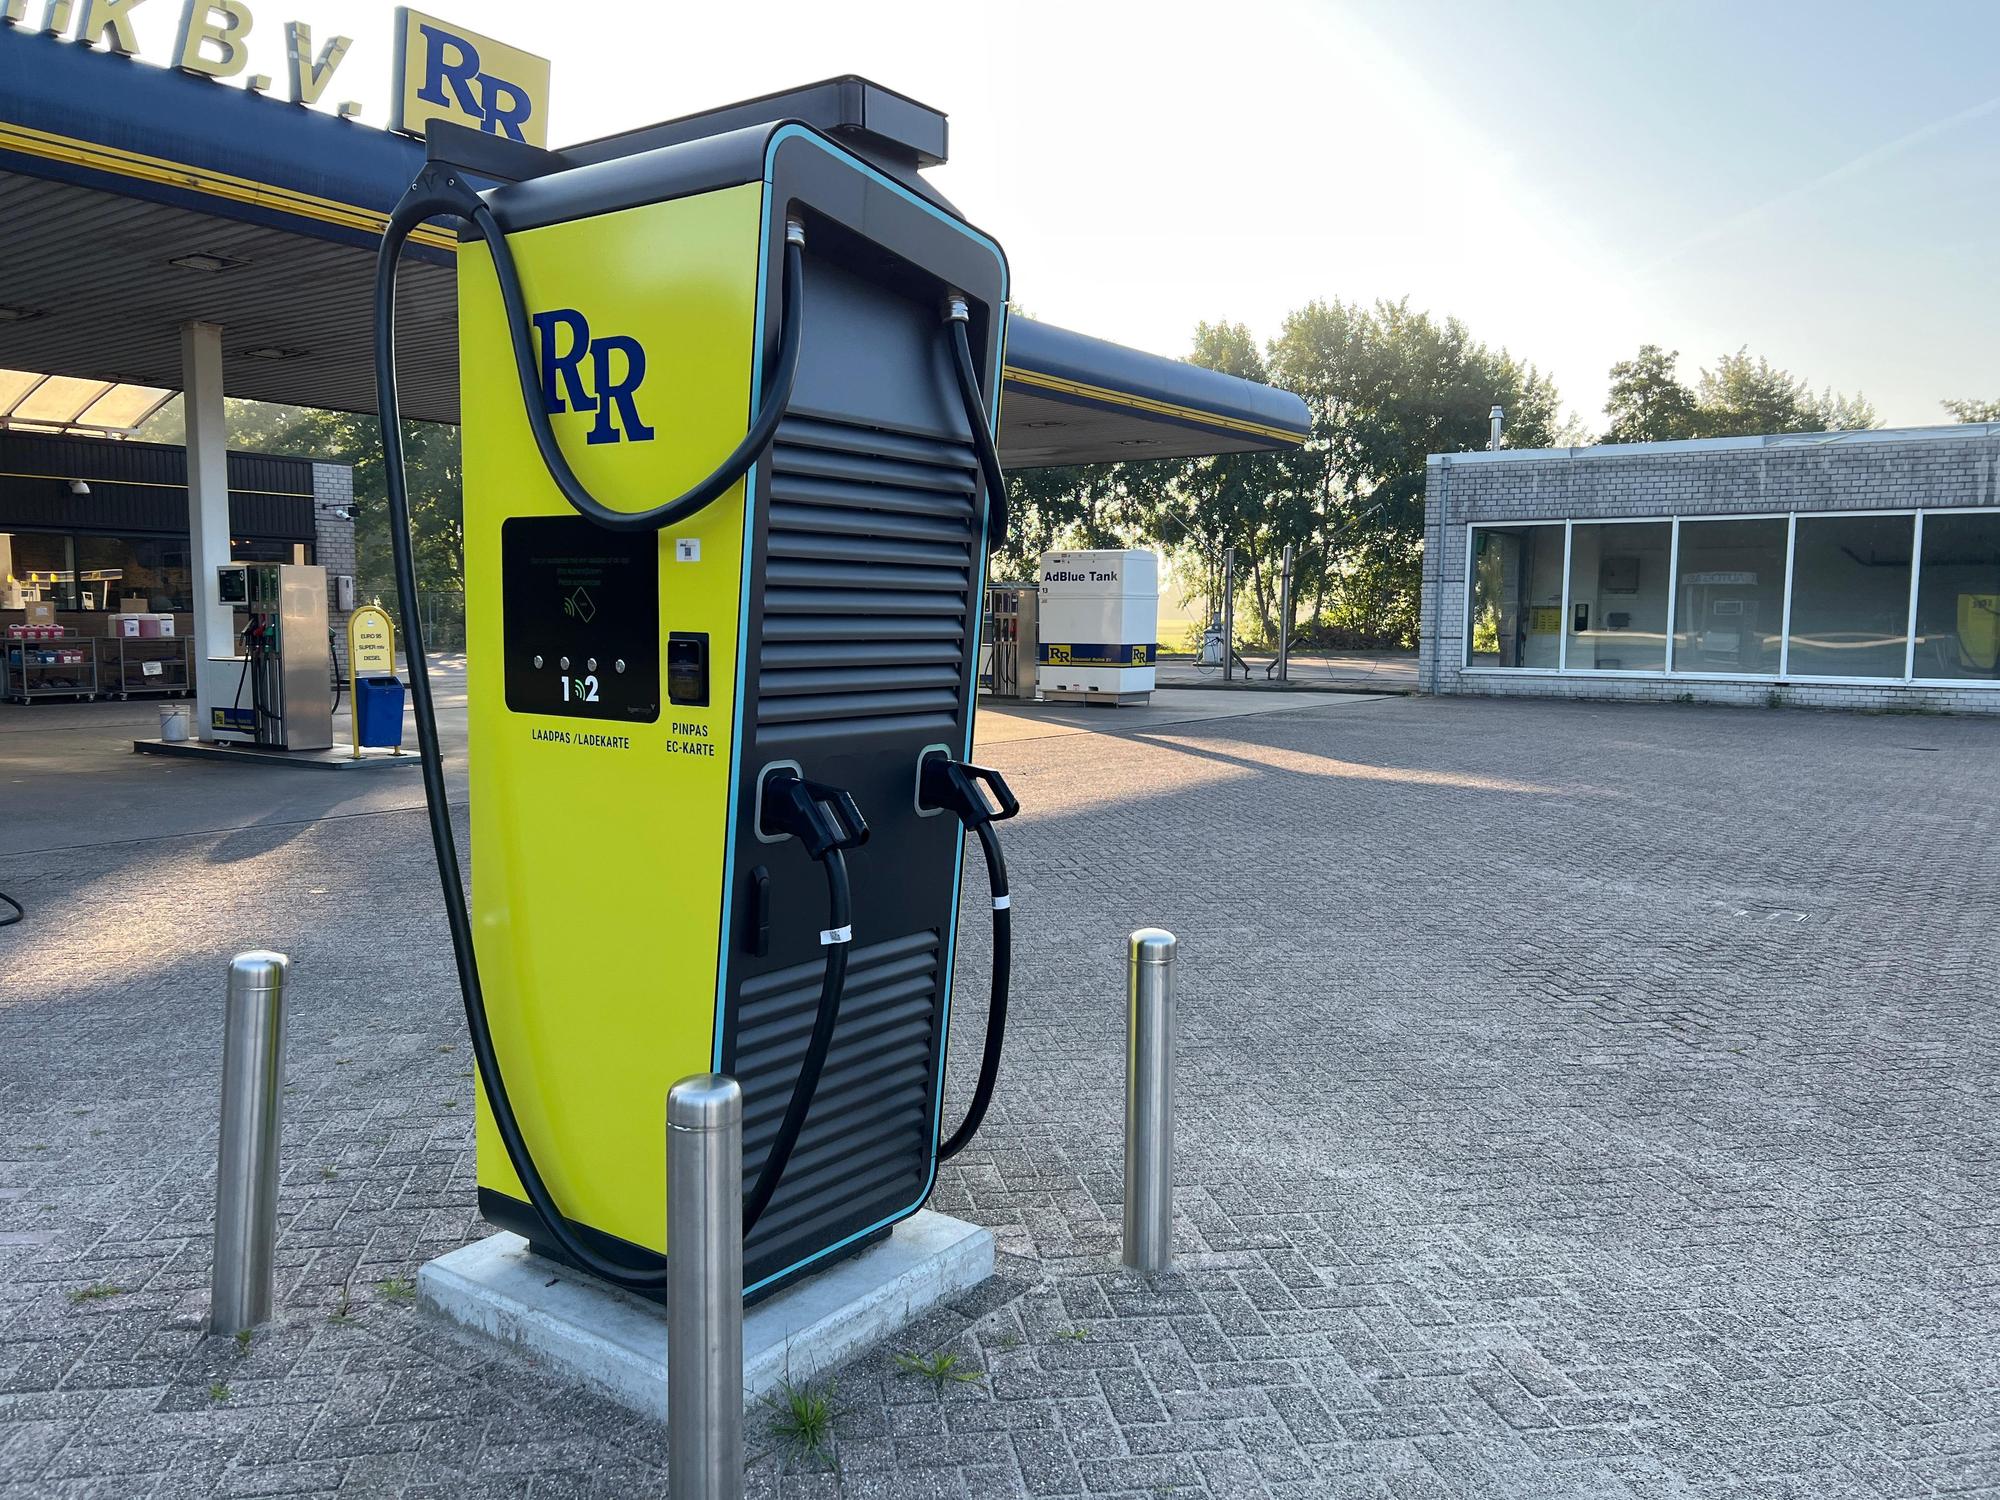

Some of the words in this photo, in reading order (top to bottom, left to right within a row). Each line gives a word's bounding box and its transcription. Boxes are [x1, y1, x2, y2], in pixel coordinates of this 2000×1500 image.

[174, 0, 362, 117] B.V.
[417, 23, 532, 143] RR
[532, 308, 655, 445] RR
[1044, 571, 1086, 582] AdBlue
[1089, 571, 1118, 582] Tank
[1050, 648, 1069, 662] RR
[1133, 650, 1145, 663] RR
[561, 675, 570, 702] 1
[585, 675, 600, 702] 2
[532, 728, 571, 744] LAADPAS
[672, 722, 708, 737] PINPAS
[666, 740, 715, 757] EC-KARTE
